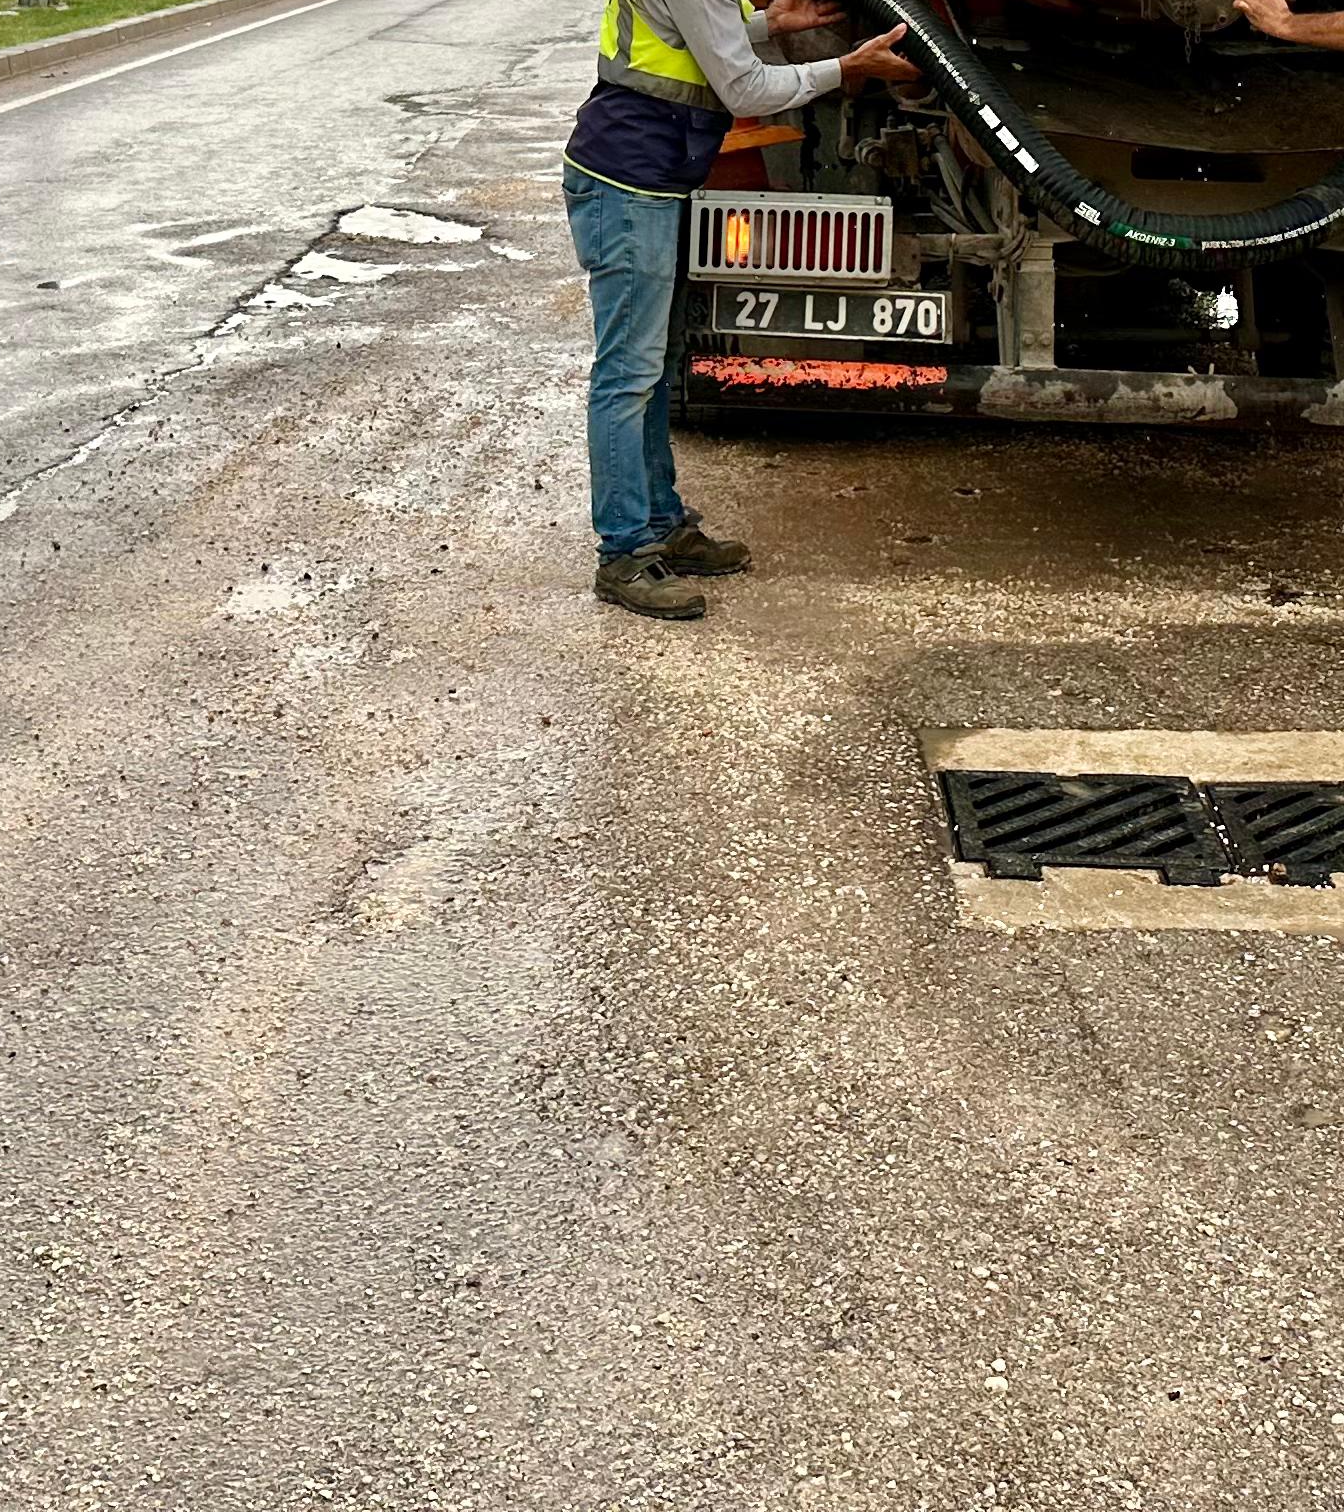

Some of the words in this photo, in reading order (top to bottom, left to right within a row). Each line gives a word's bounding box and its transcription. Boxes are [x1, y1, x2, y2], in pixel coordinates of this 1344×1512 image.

[735, 291, 779, 328] 27
[804, 294, 847, 332] LJ
[872, 297, 938, 335] 870
